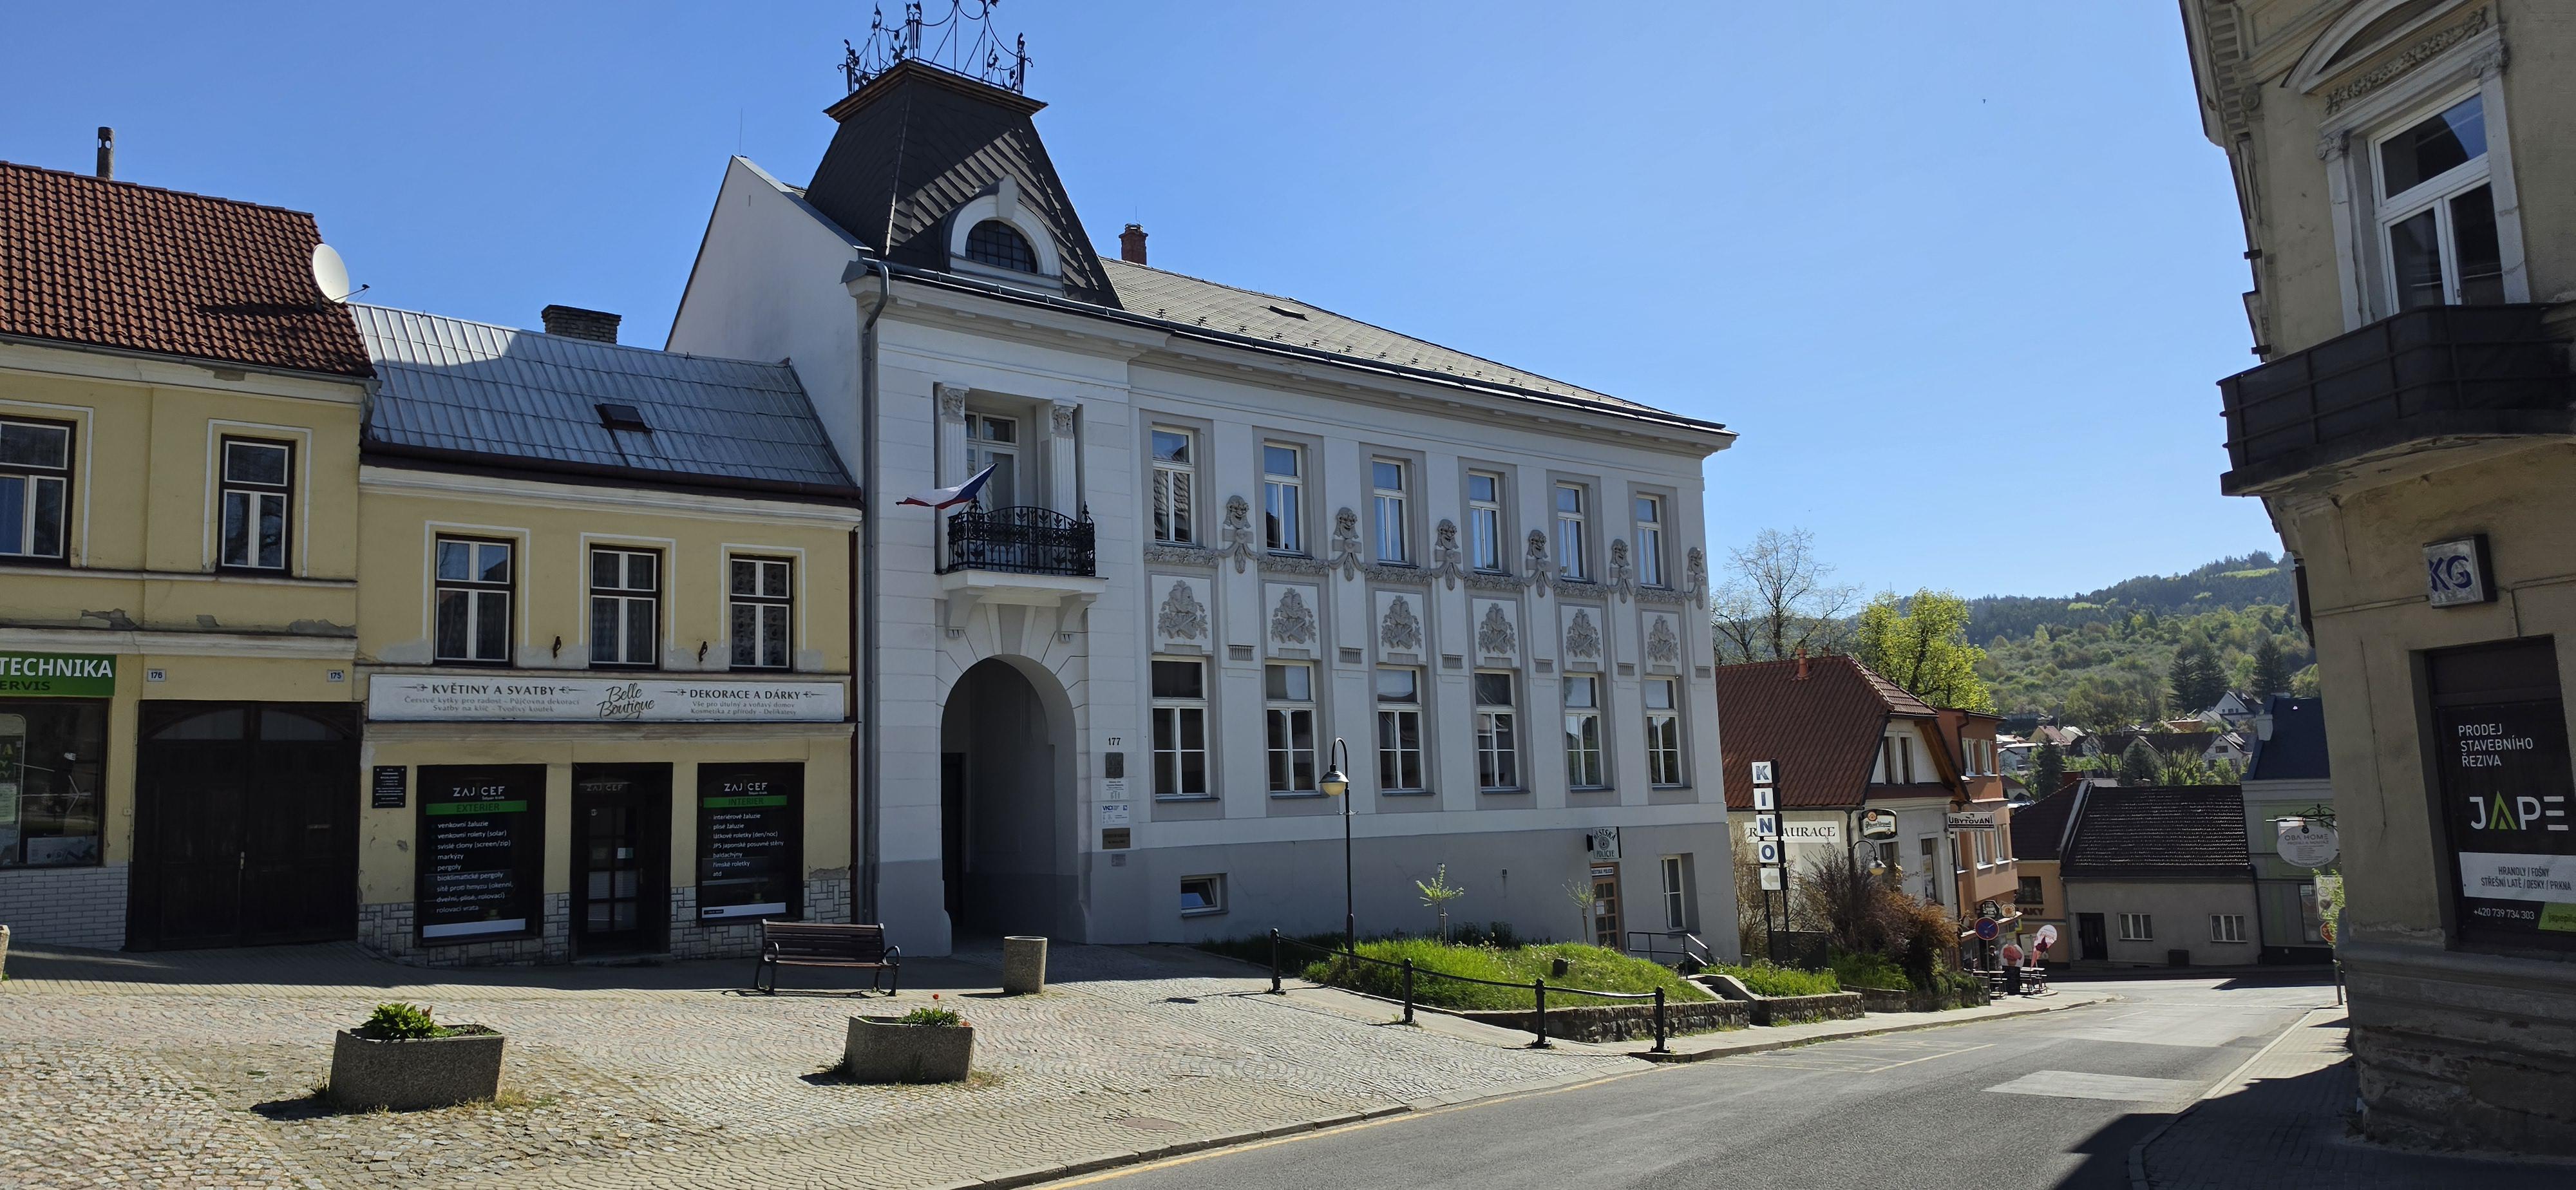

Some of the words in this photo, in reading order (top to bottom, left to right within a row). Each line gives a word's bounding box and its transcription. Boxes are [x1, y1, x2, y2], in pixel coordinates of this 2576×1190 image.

[2428, 555, 2472, 591] KG
[0, 657, 113, 677] TECHNIKA
[432, 683, 489, 694] KVĚTINY
[494, 686, 502, 694] A
[507, 686, 555, 695] SVATBY
[605, 683, 643, 702] Belle
[690, 690, 750, 699] DEKORACE
[765, 689, 800, 699] DÁRKY
[404, 695, 435, 704] Čerstvé
[596, 700, 655, 719] Boutique
[2458, 723, 2503, 737] PRODEJ
[1108, 737, 1121, 746] 177
[2460, 735, 2533, 752] STAVEBNÍHO
[2461, 753, 2502, 768] ŘEZIVA
[457, 803, 500, 813] EXTERIER
[728, 797, 764, 806] INTERIER
[1755, 764, 1776, 860] KINO
[2469, 790, 2569, 831] JAPE
[1749, 826, 1835, 837] RAURACE
[475, 840, 511, 848] (screen/zip)
[2498, 865, 2526, 876] HRANOLY
[2531, 866, 2550, 877] FOŠNY
[2481, 876, 2506, 887] STŘEŠNÍ
[2526, 880, 2544, 889] DESKY
[2550, 880, 2571, 891] PRKNA
[2474, 907, 2490, 916] +420
[2492, 908, 2505, 918] 739
[2506, 909, 2519, 918] 734
[2521, 911, 2535, 920] 303
